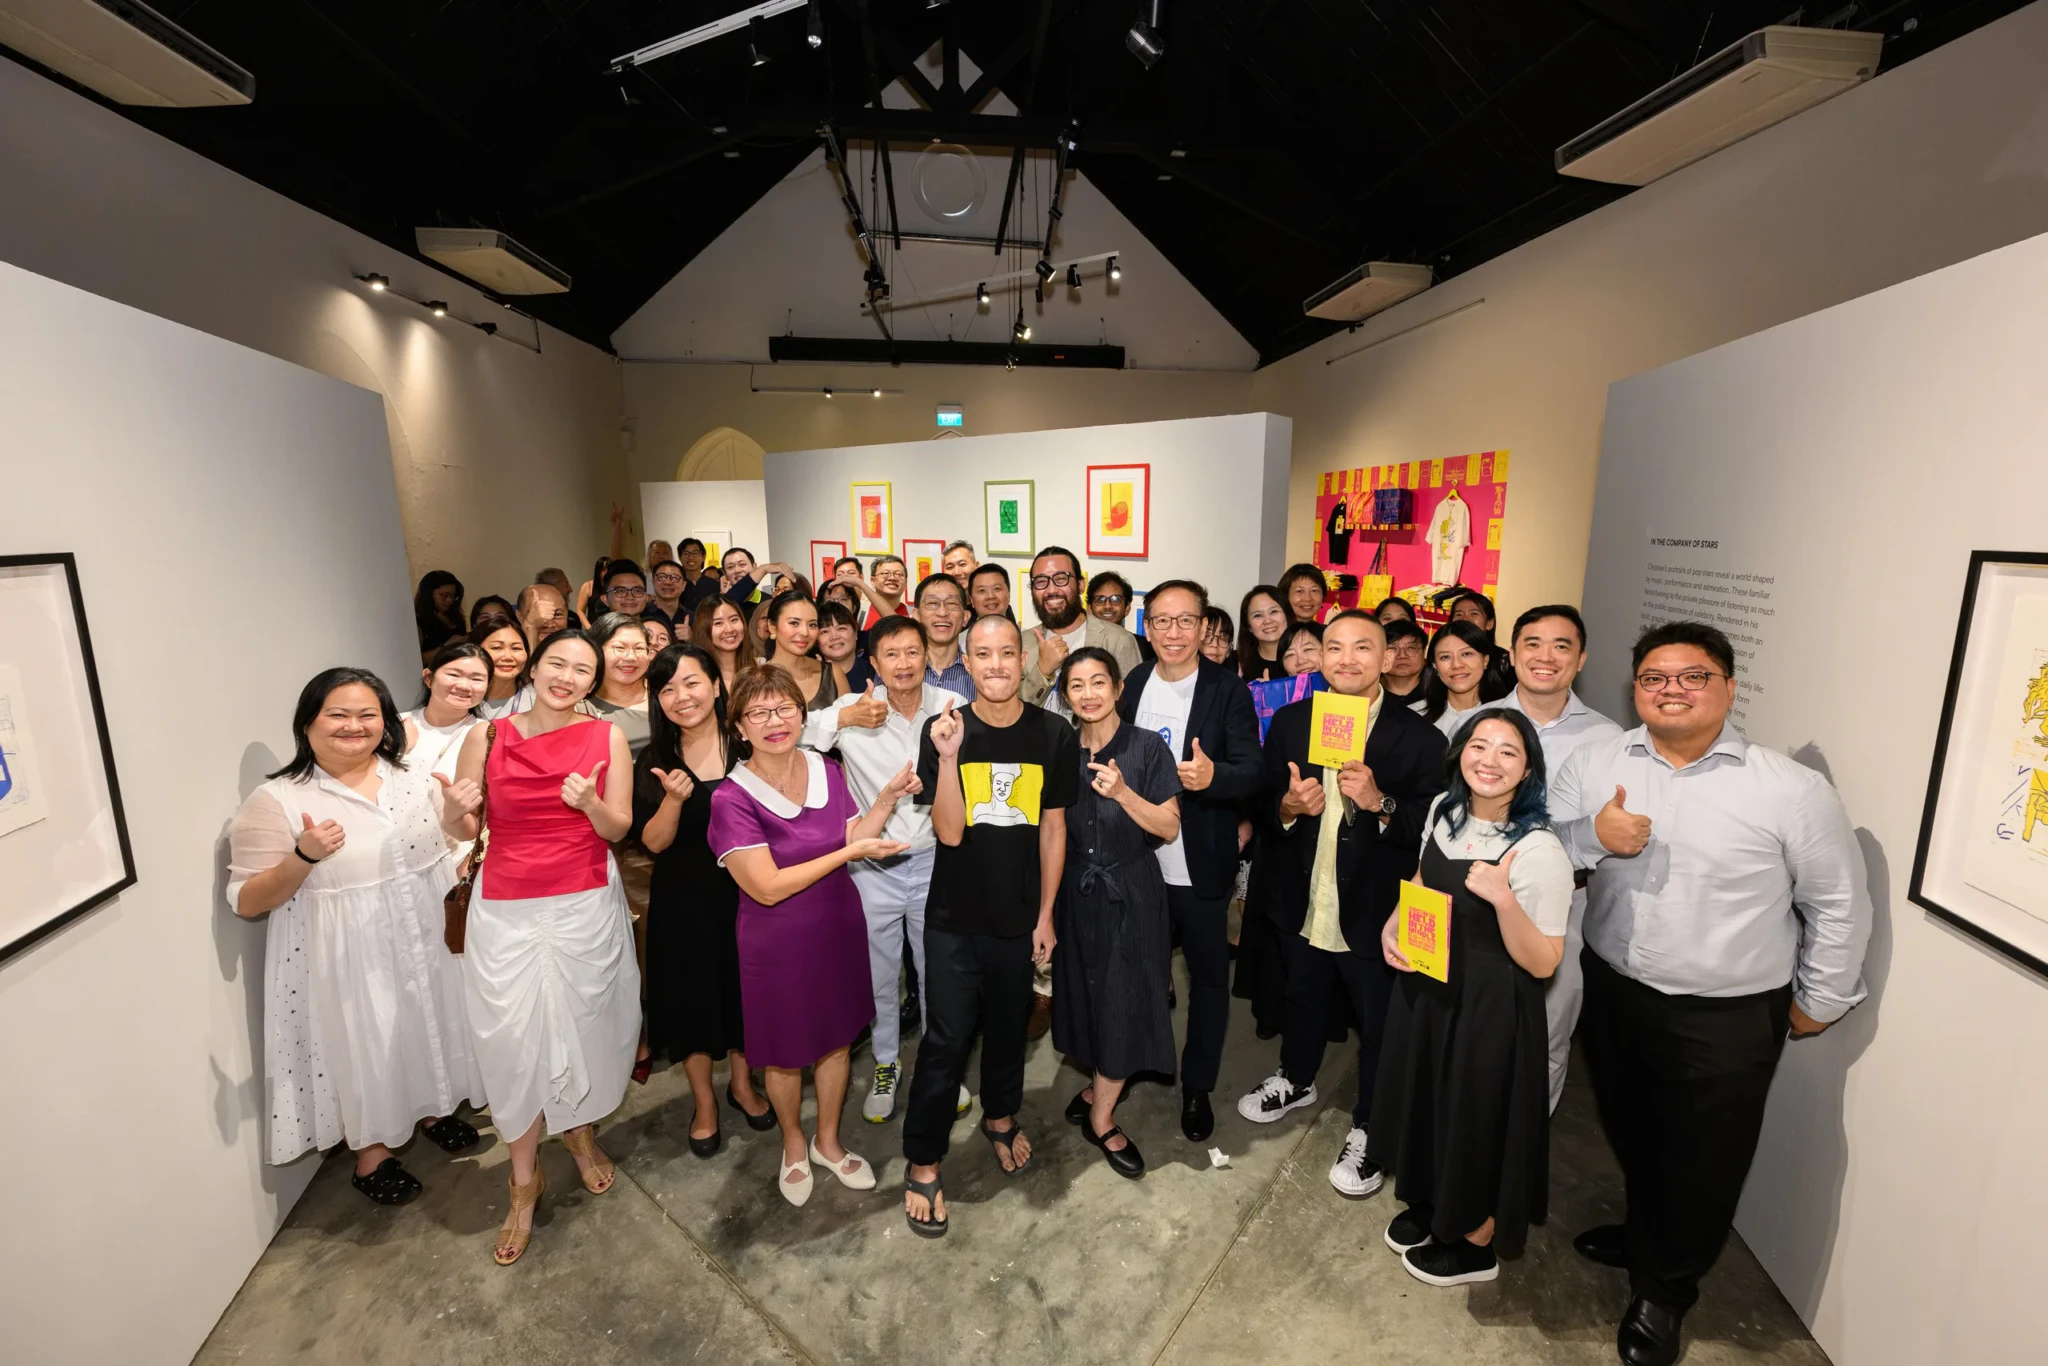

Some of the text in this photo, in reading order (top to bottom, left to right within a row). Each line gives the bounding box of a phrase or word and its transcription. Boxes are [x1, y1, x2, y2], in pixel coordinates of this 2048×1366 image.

[1666, 539, 1692, 547] COMPANY
[1693, 540, 1700, 548] OF
[1701, 540, 1718, 549] STARS
[1668, 566, 1686, 574] portraits
[1687, 567, 1692, 575] of
[1692, 569, 1702, 577] pop
[1715, 571, 1730, 579] reveal
[1736, 573, 1751, 581] world
[1752, 574, 1774, 584] shaped
[1664, 578, 1692, 589] performance
[1703, 584, 1730, 594] admiration.
[1732, 586, 1748, 596] These
[1749, 588, 1770, 599] familiar
[1682, 595, 1698, 603] private
[1699, 596, 1719, 607] pleasure
[1720, 600, 1726, 608] of
[1727, 601, 1749, 614] listening
[1758, 607, 1775, 616] much
[1668, 606, 1687, 616] spectacle
[1689, 608, 1694, 616] of
[1694, 610, 1715, 622] celebrity.
[1717, 614, 1742, 626] Rendered
[1744, 618, 1749, 627] in
[1750, 620, 1758, 629] his
[1741, 633, 1754, 643] both
[1739, 680, 1753, 692] daily
[1737, 693, 1750, 705] form
[1734, 708, 1746, 719] time
[1323, 717, 1354, 728] HELD
[1332, 726, 1353, 735] THE
[1409, 911, 1435, 928] HELD
[1418, 922, 1435, 936] THE
